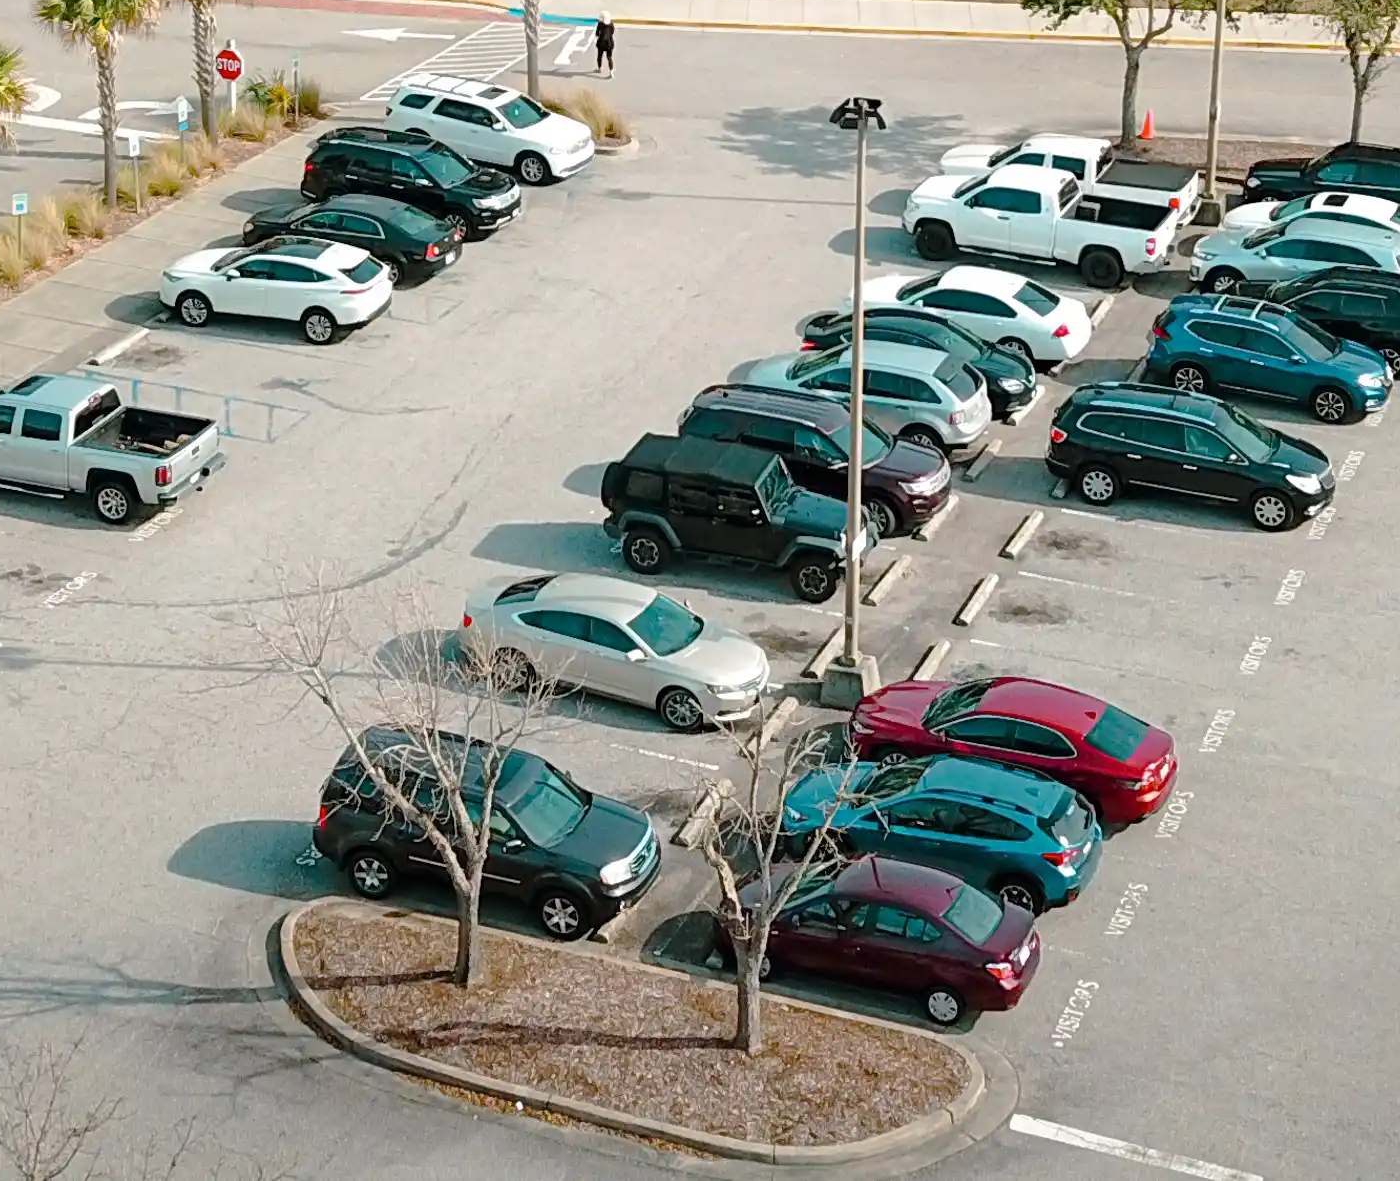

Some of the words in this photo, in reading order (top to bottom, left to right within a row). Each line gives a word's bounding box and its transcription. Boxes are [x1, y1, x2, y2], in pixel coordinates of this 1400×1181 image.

[217, 58, 240, 72] STOP
[128, 506, 184, 541] VISITORS
[1273, 568, 1306, 606] VISITORS
[1239, 634, 1272, 675] VISITORS
[1199, 709, 1236, 752] VISITORS
[1154, 790, 1194, 839] VISITORS
